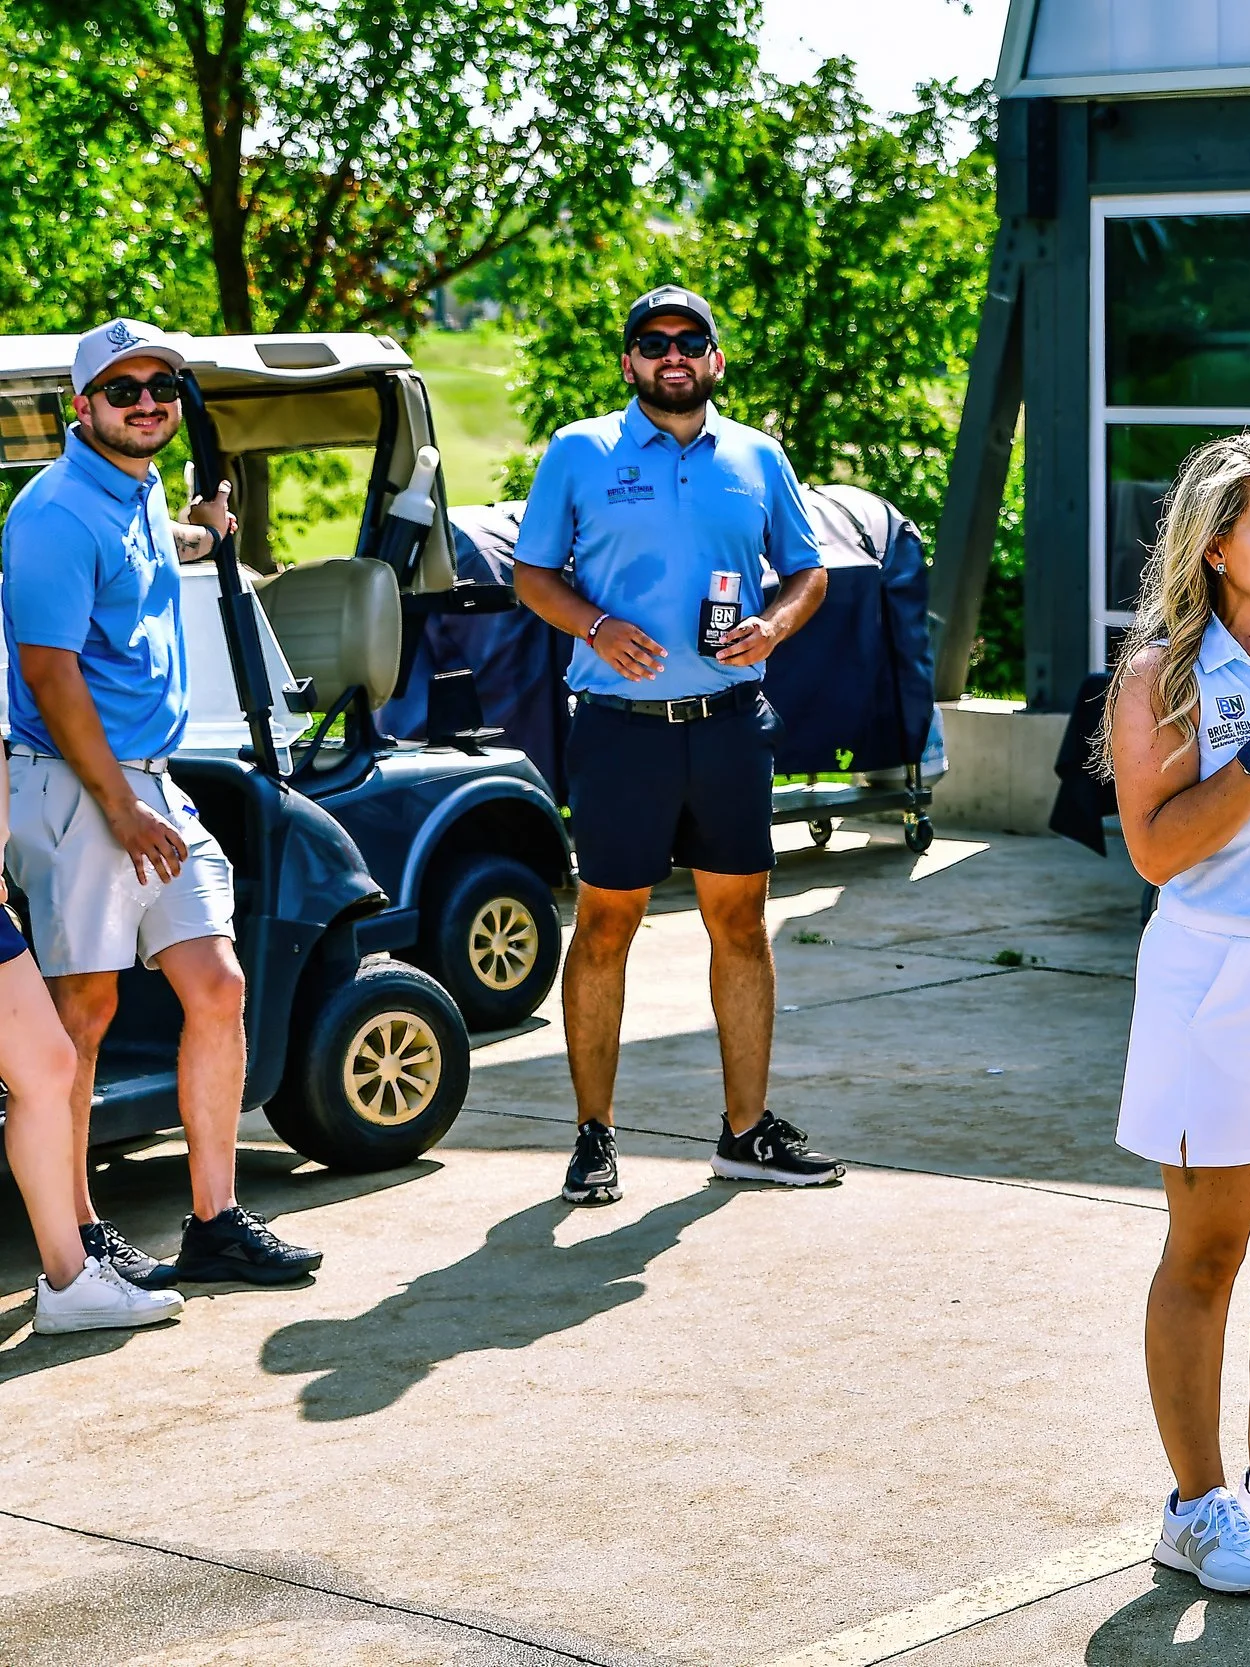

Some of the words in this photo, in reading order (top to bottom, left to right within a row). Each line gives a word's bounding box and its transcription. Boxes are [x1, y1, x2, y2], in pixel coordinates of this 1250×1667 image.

[714, 608, 734, 622] BN
[1219, 697, 1242, 712] BN
[1207, 722, 1233, 739] BRICE
[1209, 732, 1236, 744] MEMORIAL
